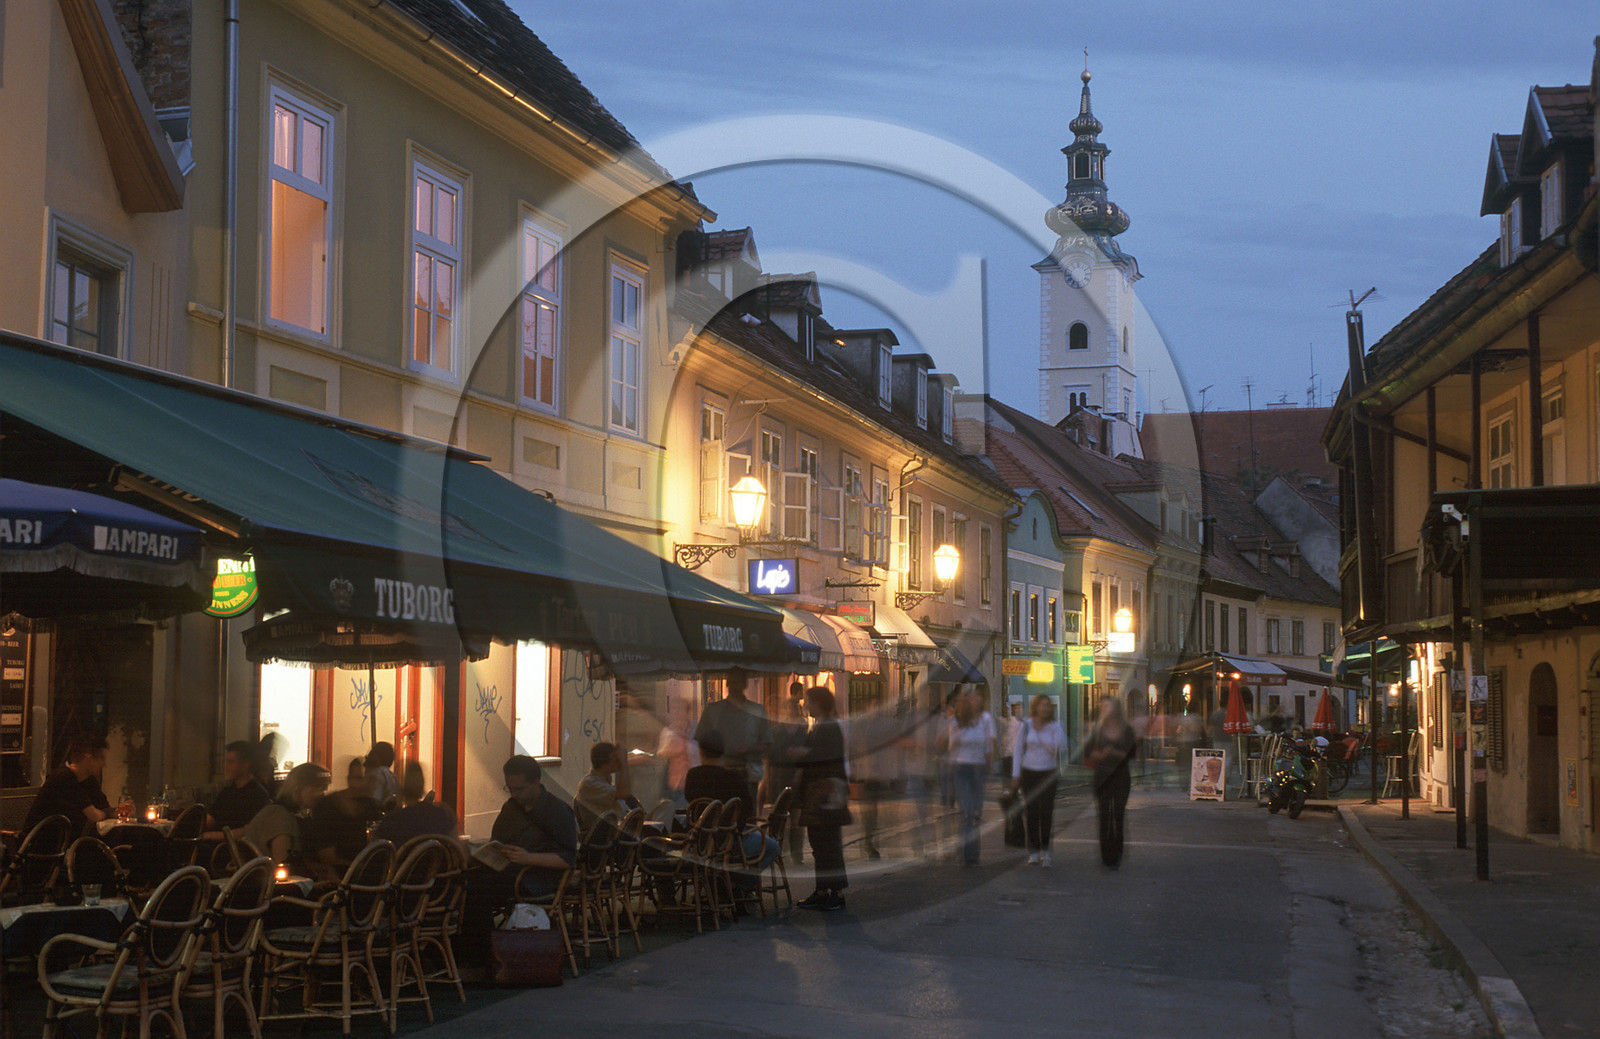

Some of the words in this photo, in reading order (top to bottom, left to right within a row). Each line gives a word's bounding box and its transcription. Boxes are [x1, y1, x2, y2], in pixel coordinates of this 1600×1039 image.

[93, 525, 179, 560] AMPARI
[374, 577, 455, 625] TUBORG
[703, 624, 743, 653] TUBORG
